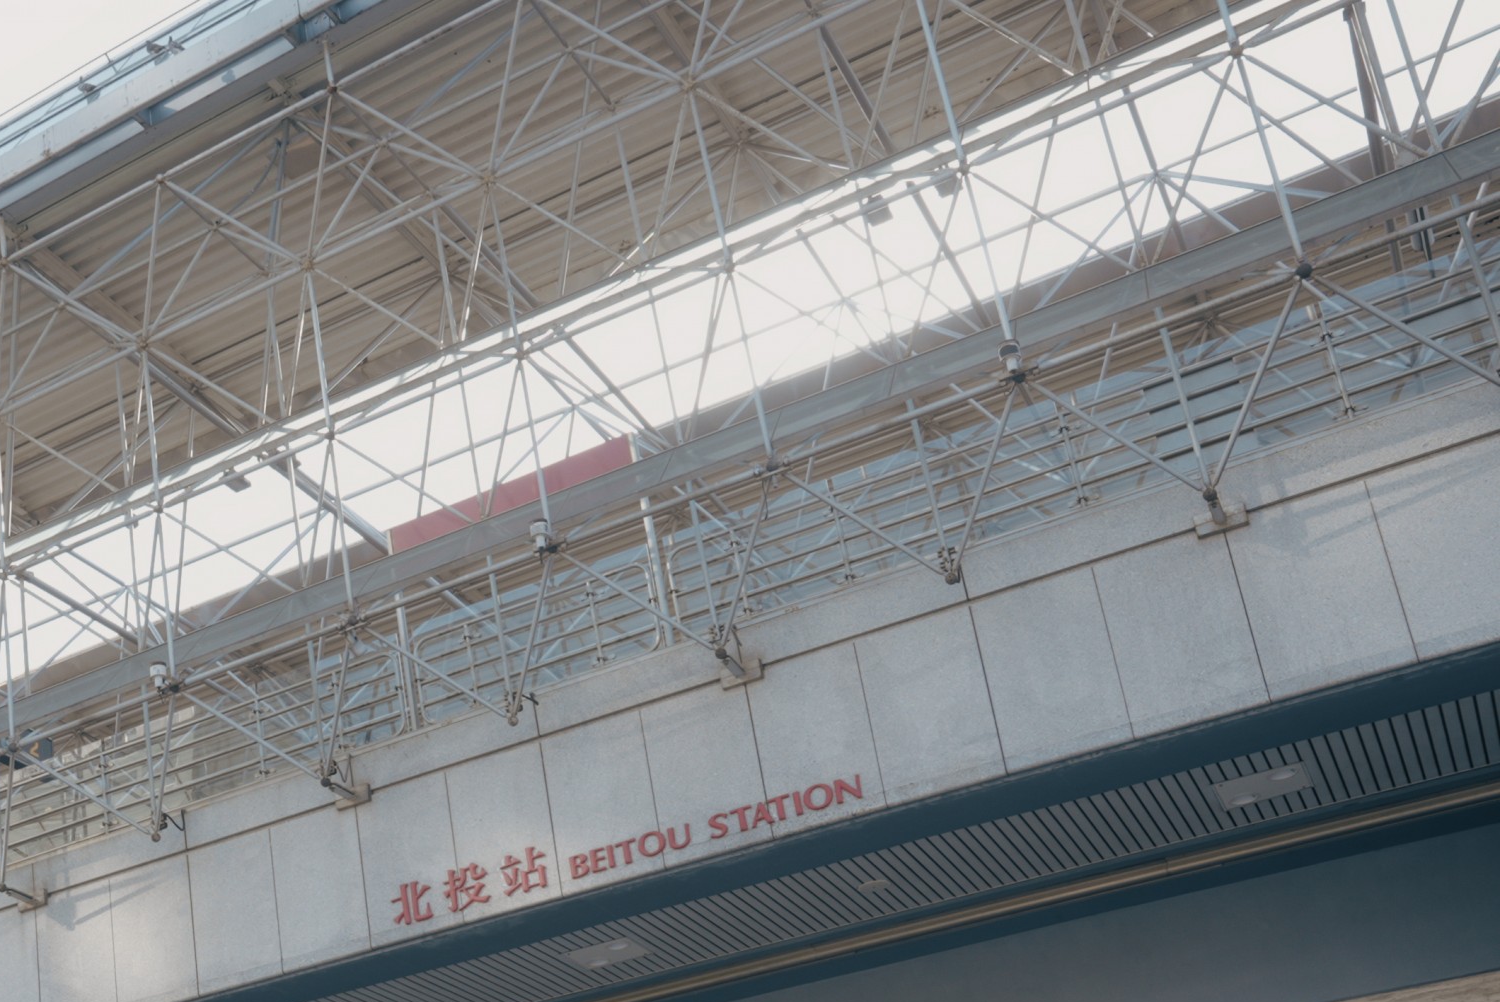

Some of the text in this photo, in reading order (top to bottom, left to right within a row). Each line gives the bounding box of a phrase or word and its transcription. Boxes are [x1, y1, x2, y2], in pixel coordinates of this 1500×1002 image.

[569, 774, 864, 879] BEITOU STATION
[391, 847, 547, 925] 北投站
